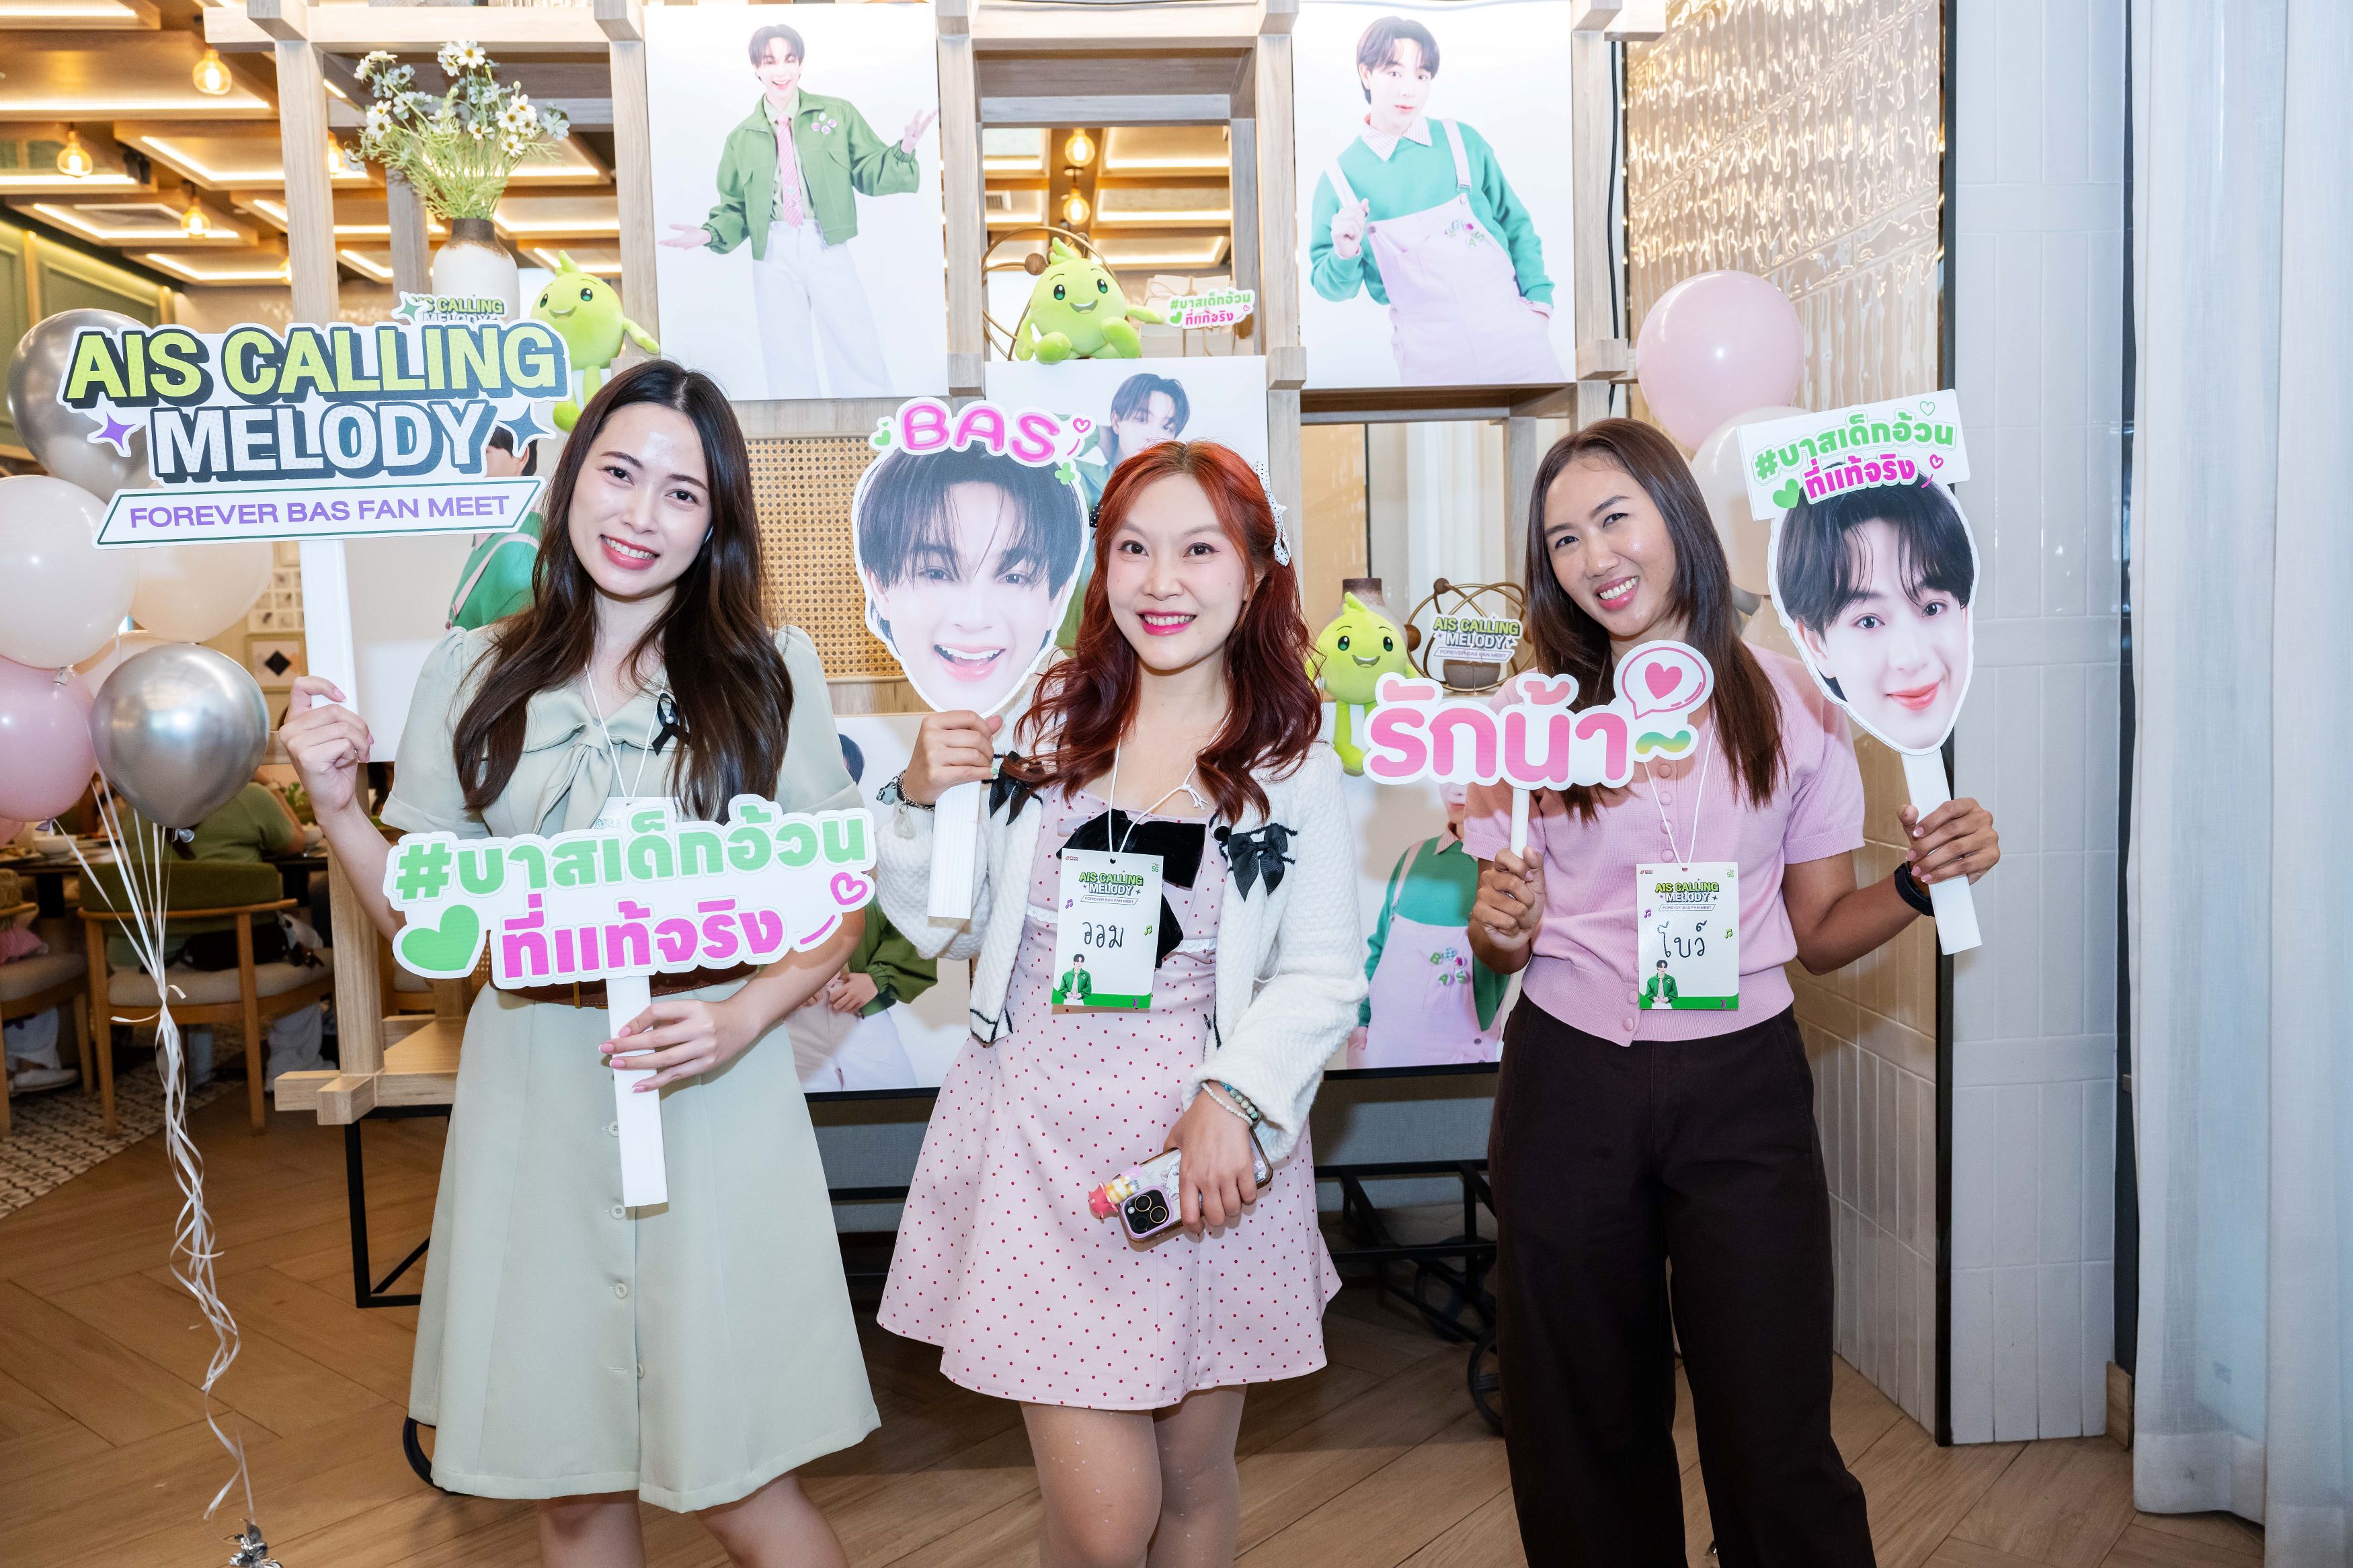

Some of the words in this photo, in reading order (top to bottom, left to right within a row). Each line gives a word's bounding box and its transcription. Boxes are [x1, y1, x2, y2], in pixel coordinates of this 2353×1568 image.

[437, 297, 504, 314] CALLING
[1170, 291, 1250, 311] #บาสเด็กอ้วน
[64, 328, 208, 405] AIS
[221, 322, 568, 400] CALLING
[153, 401, 498, 483] MELODY
[900, 401, 1060, 462] BAS
[1755, 411, 1954, 481] #บาสเด็กอ้วน
[1804, 453, 1915, 499] ที่แท้จริง
[130, 503, 278, 528] FOREVER
[287, 499, 352, 523] BAS
[358, 497, 421, 520] FAN
[428, 495, 510, 518] MEET
[1433, 617, 1458, 632] AIS
[1460, 618, 1520, 636] CALLING
[1445, 632, 1505, 649] MELODY
[1370, 679, 1628, 784] รักน้า
[395, 804, 866, 901] #บาสเด็กอ้วน
[1079, 872, 1098, 883] AIS
[1099, 872, 1144, 886] CALLING
[1089, 883, 1134, 895] MELODY
[1654, 882, 1673, 893] AIS
[1675, 882, 1719, 893] CALLING
[1665, 893, 1710, 903] MELODY
[501, 893, 783, 979] ที่แท้จริง
[1082, 921, 1124, 948] ออม
